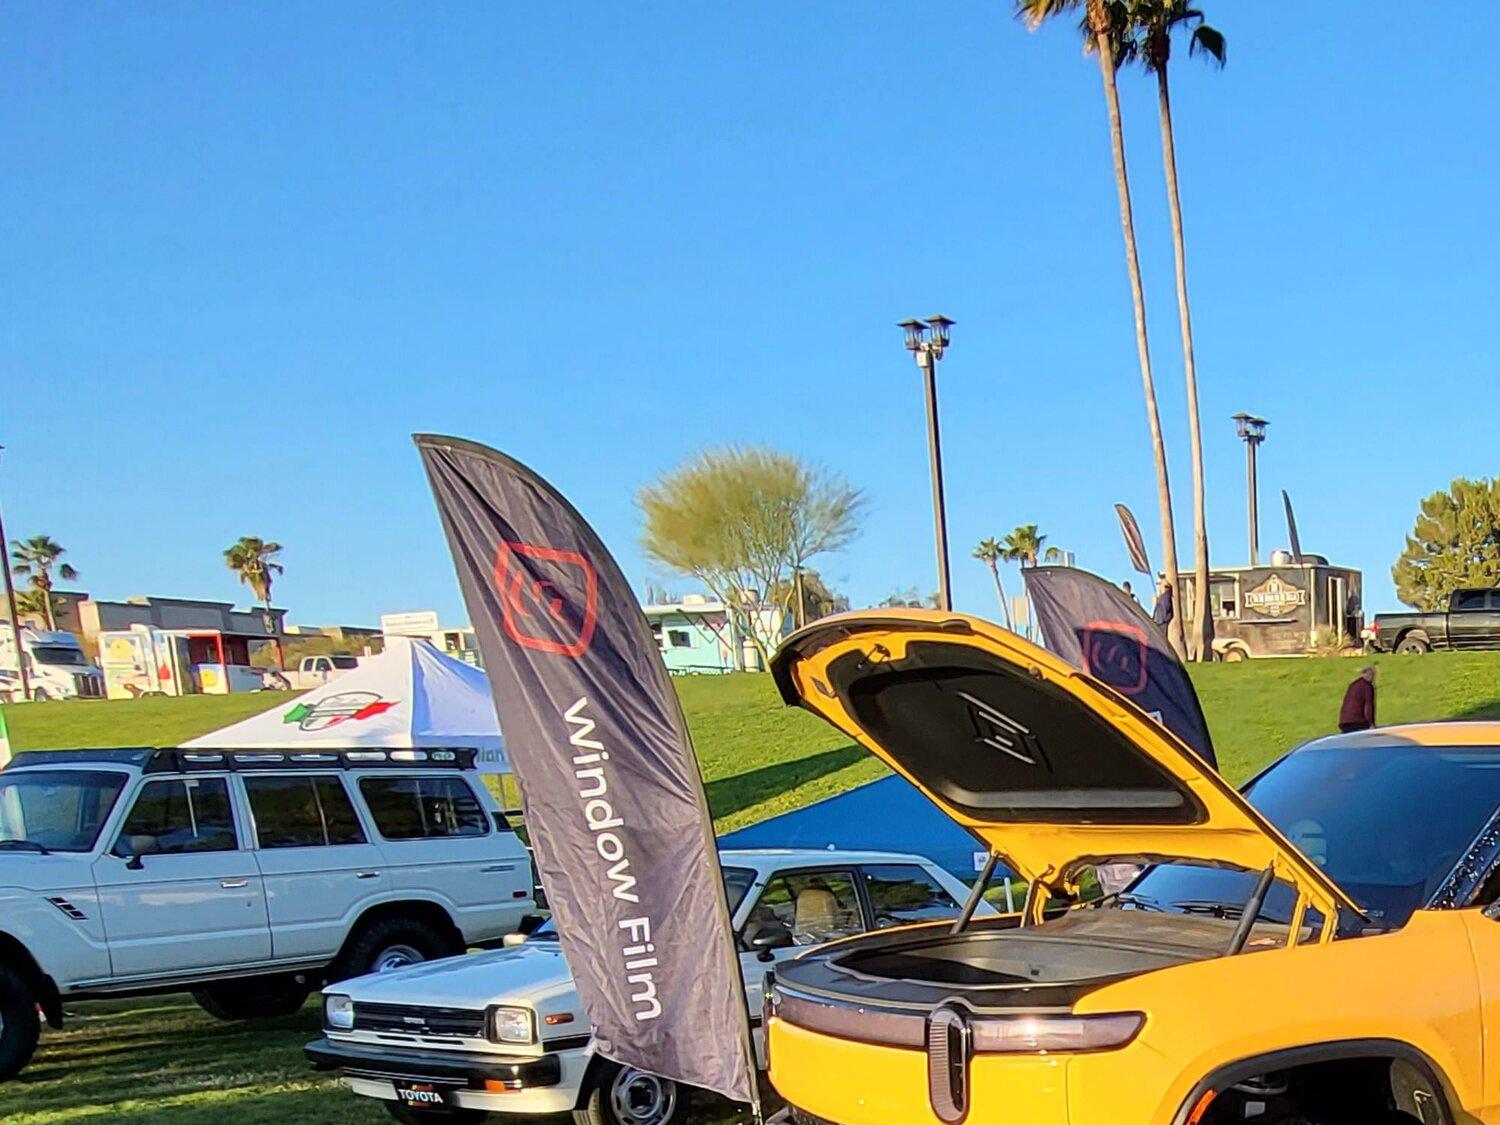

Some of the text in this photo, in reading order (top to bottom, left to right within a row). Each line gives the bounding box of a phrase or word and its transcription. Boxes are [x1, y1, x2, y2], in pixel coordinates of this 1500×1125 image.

[564, 696, 662, 1020] Window Film
[398, 1088, 444, 1104] TOYOTA
